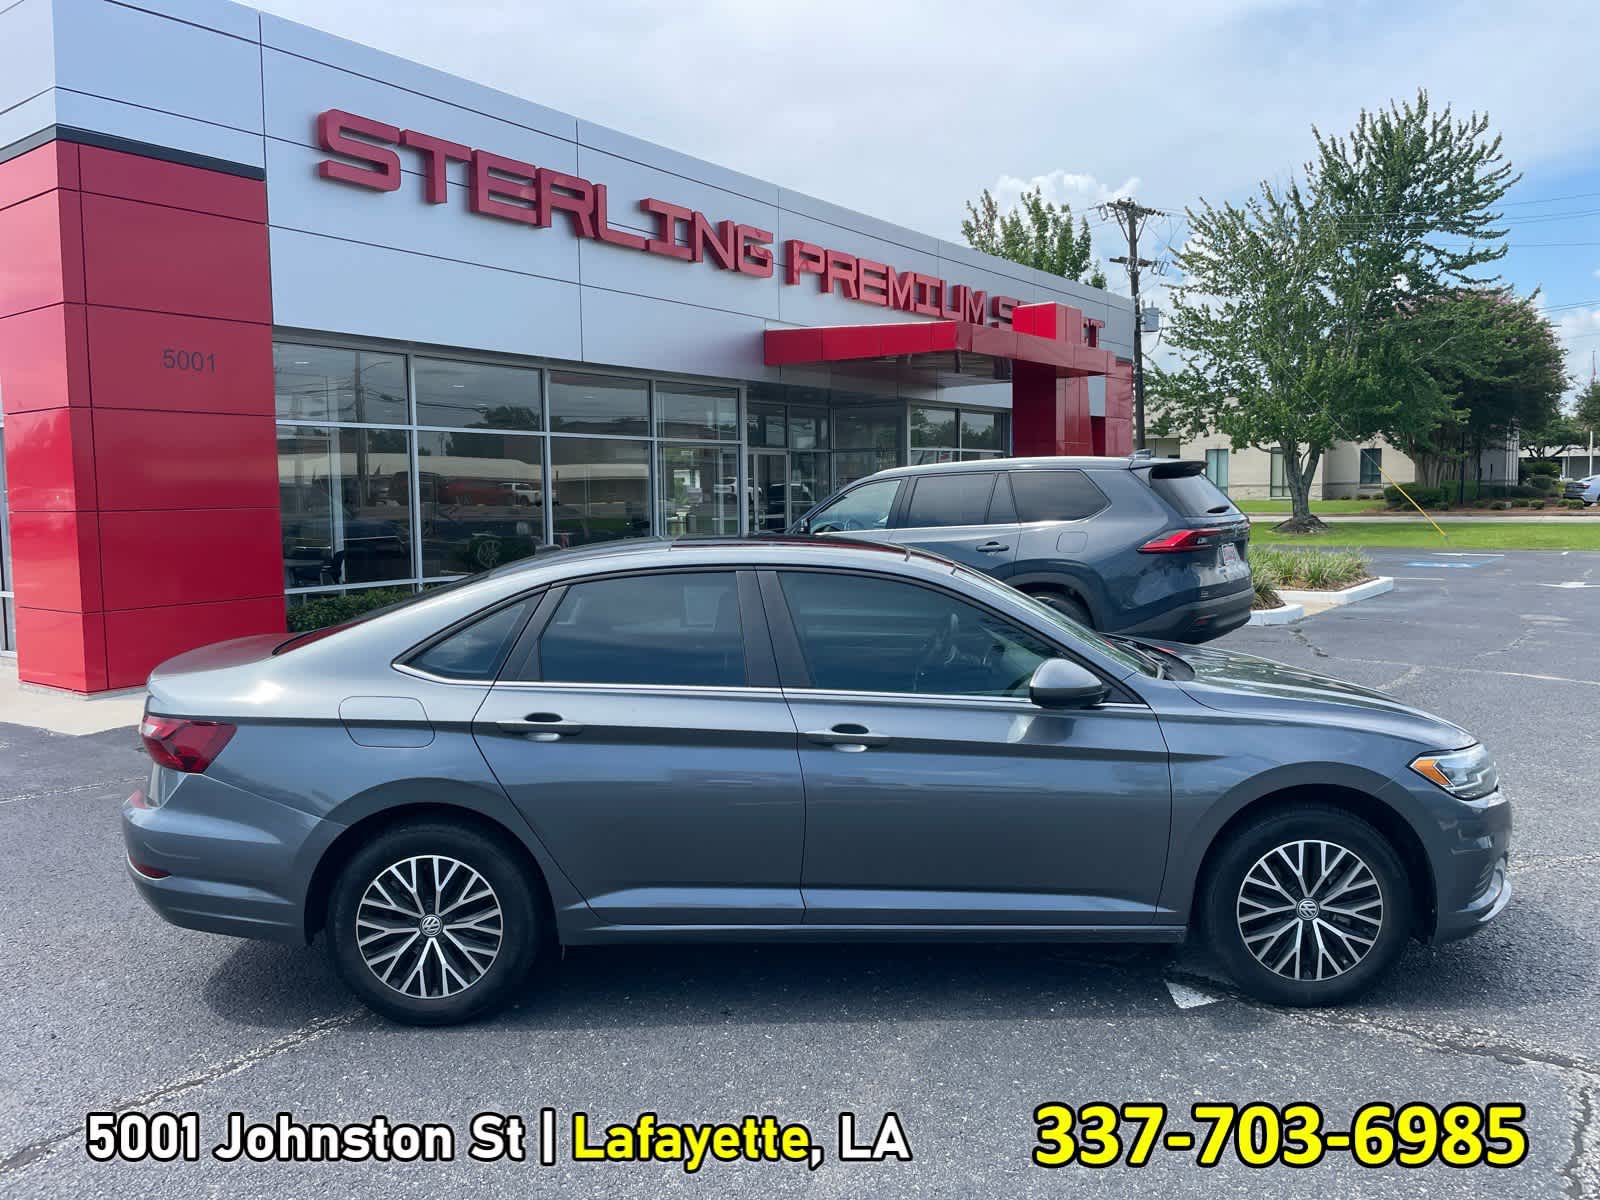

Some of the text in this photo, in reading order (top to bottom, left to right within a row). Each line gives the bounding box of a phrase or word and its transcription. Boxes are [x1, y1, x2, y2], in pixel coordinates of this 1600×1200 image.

[318, 108, 774, 278] STERLING
[785, 239, 988, 325] PREMIUM
[162, 348, 217, 373] 5001
